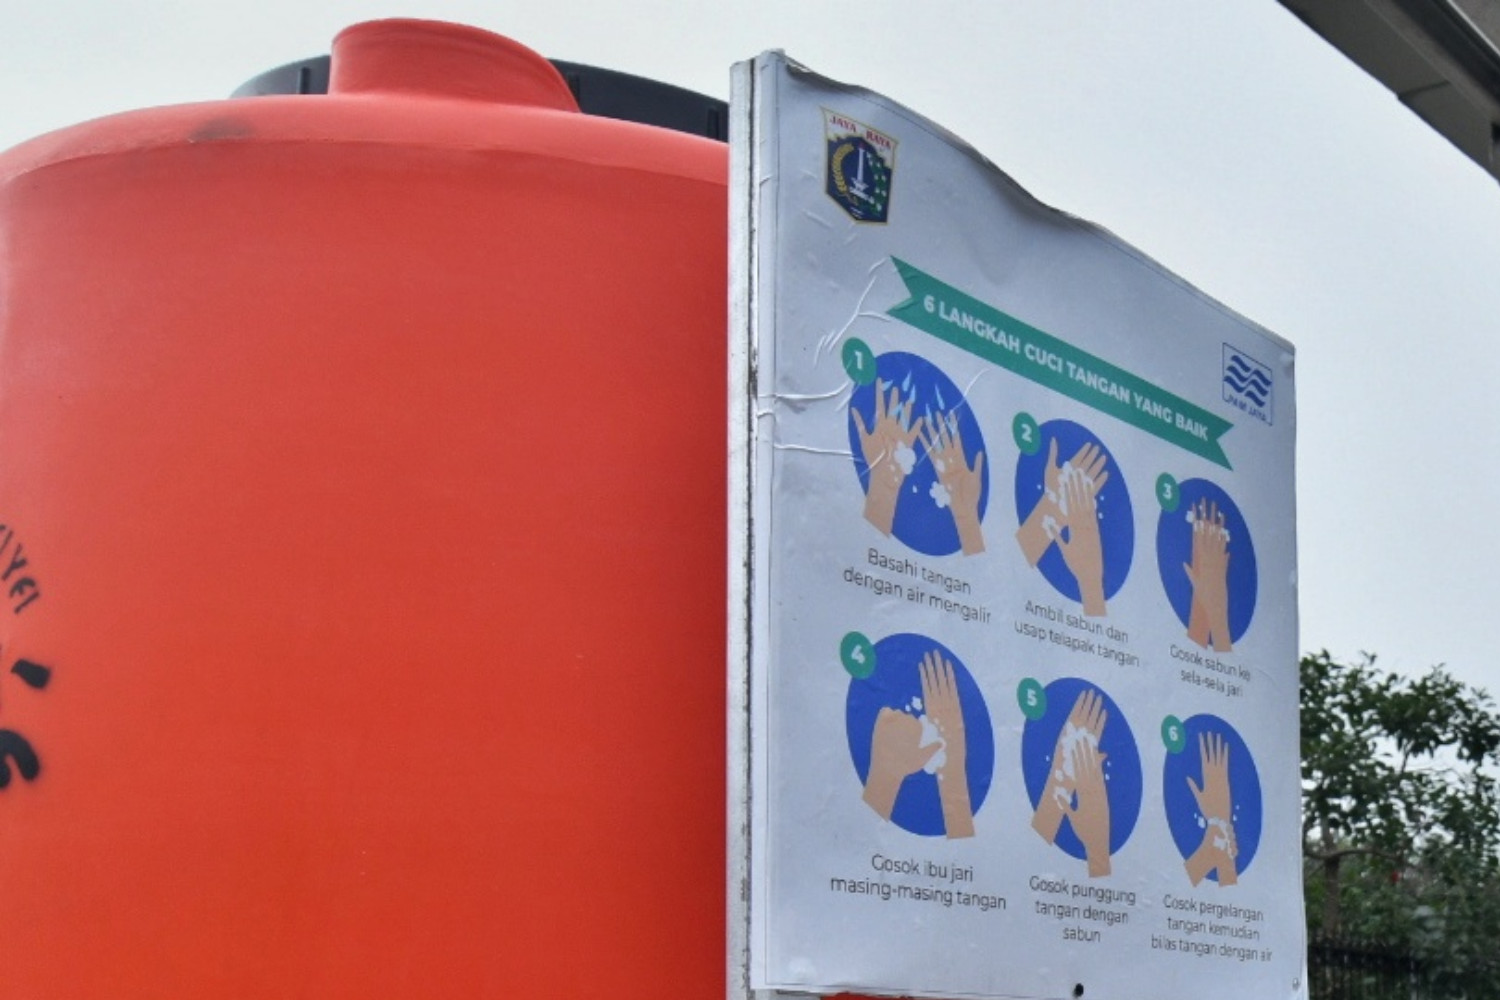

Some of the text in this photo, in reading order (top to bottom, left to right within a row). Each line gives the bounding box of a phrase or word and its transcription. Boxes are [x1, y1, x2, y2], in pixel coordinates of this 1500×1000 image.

[829, 115, 892, 149] JAYA RAYA
[853, 350, 864, 370] 1
[923, 294, 1209, 441] 6 LANGKAH CUCI TANGAN YANG BAIK
[1021, 423, 1032, 443] 2
[1163, 483, 1173, 500] 3
[867, 547, 972, 596] Basahi tangan
[843, 566, 992, 624] dengan air mengalir
[1025, 600, 1129, 644] Ambil sabun dan
[851, 645, 865, 664] 4
[1014, 620, 1140, 668] usap telapak tangan
[1169, 643, 1251, 682] Gosok sabun ke
[1180, 669, 1225, 693] sela-sela
[1026, 689, 1038, 706] 5
[1168, 726, 1178, 743] 6
[871, 853, 973, 884] Gosok ibu jari
[830, 877, 1007, 912] masing-masing tangan
[1029, 875, 1136, 906] Gosok punggung
[1035, 900, 1129, 926] tangan dengan
[1199, 900, 1265, 923] pergelangan
[1062, 926, 1101, 942] sabun
[1167, 916, 1261, 941] tangan kemudian
[1151, 933, 1274, 962] bilas tangan dengan air
